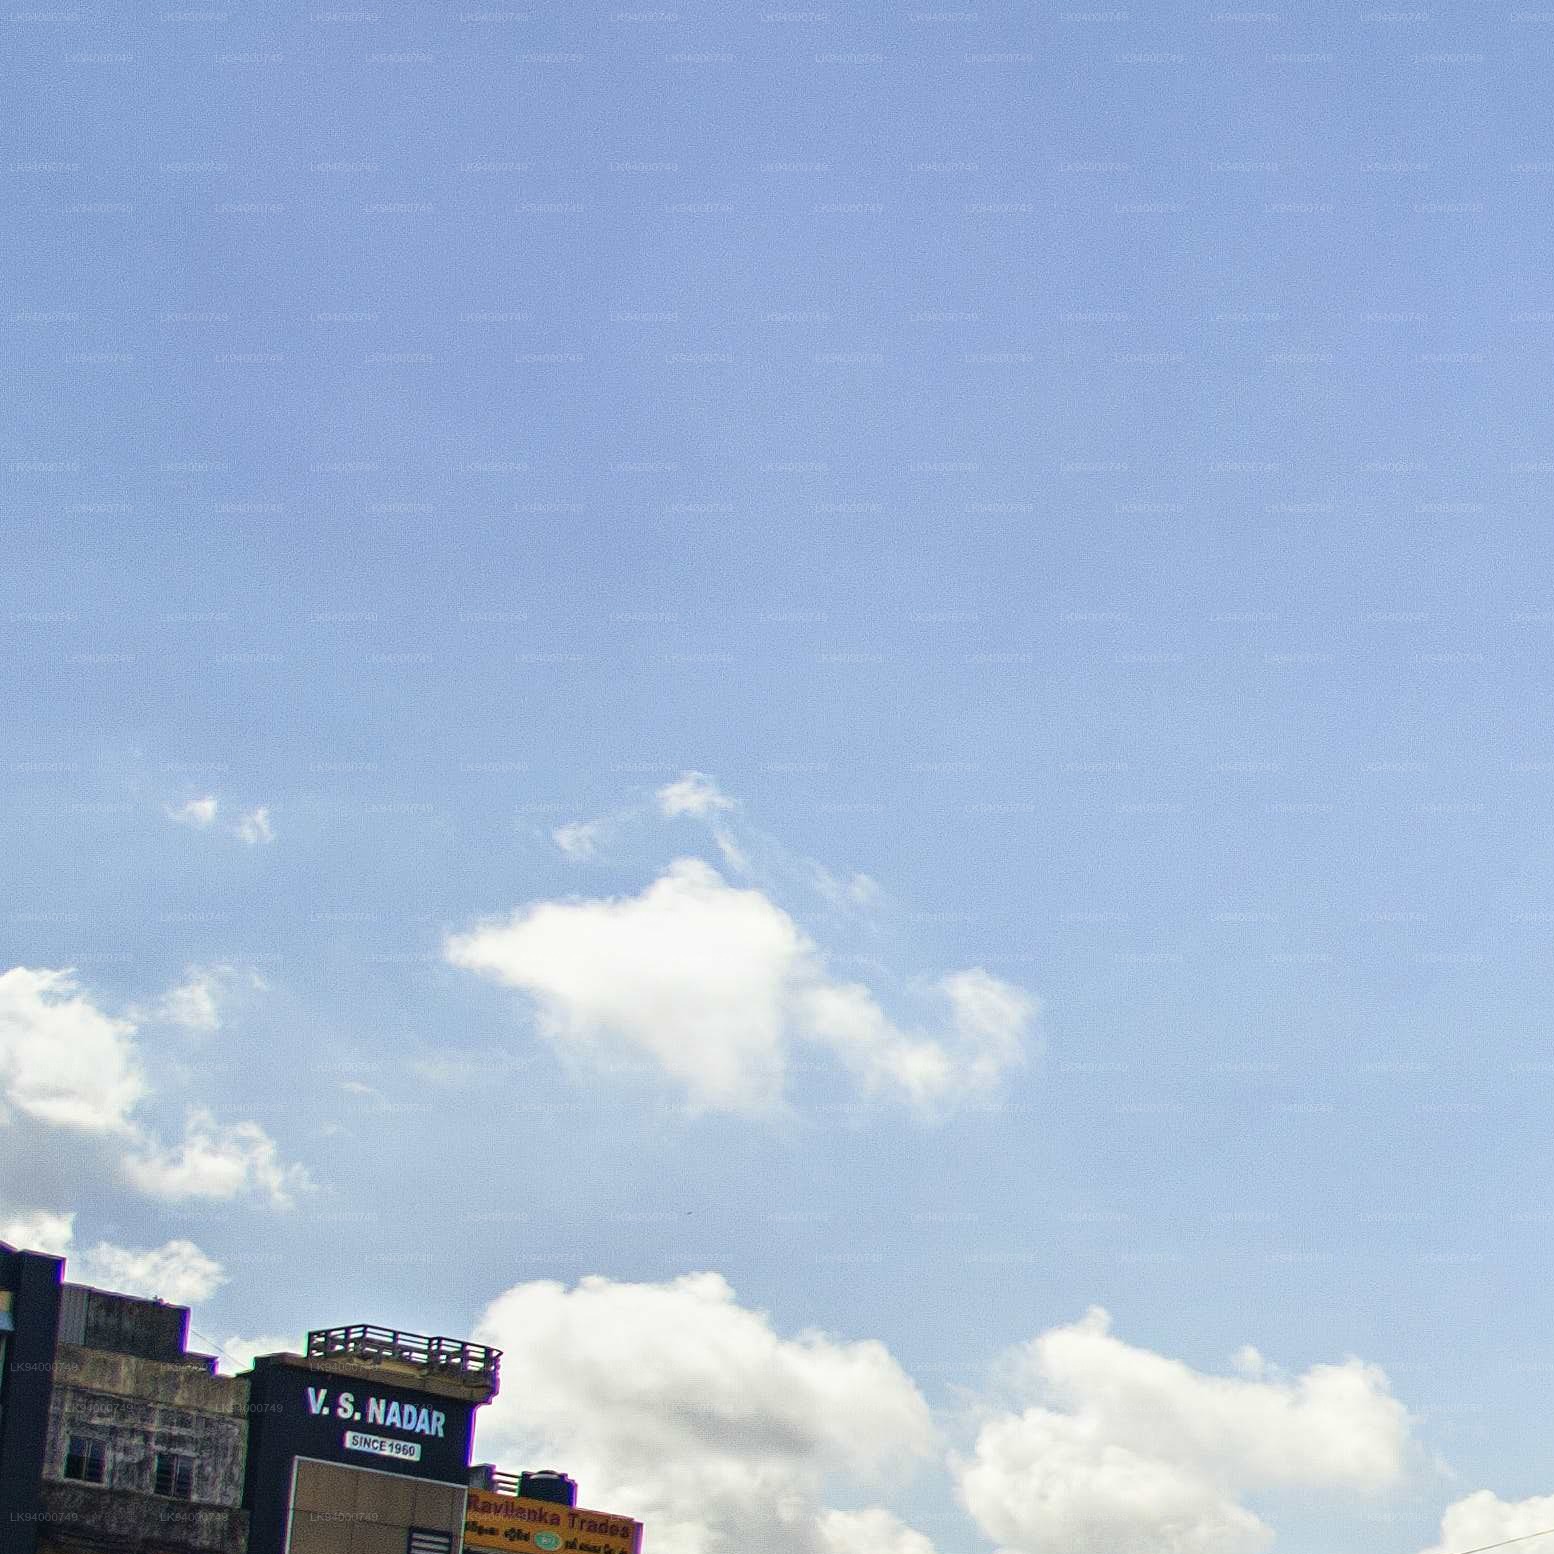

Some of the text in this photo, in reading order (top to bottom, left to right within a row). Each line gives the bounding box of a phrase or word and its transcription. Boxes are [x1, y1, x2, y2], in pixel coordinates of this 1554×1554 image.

[307, 1387, 447, 1439] V. S. NADAR
[351, 1435, 387, 1453] SINCE
